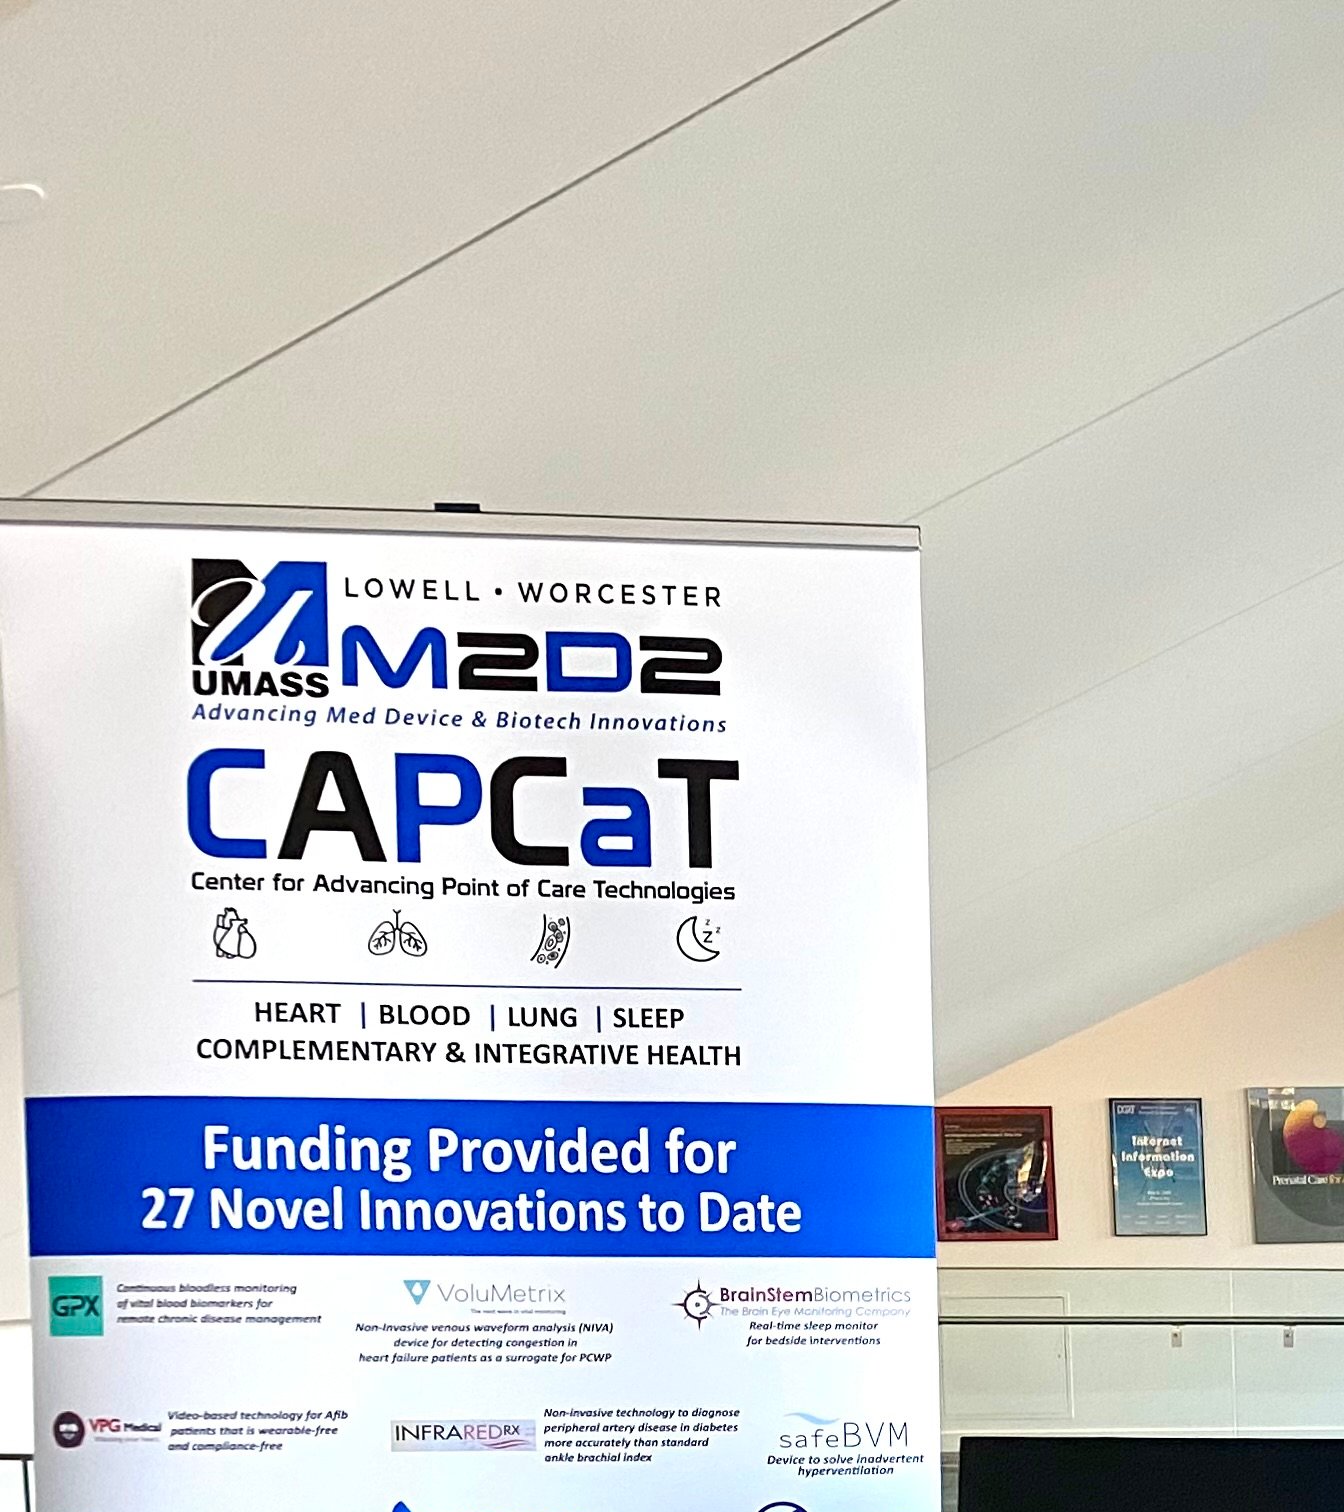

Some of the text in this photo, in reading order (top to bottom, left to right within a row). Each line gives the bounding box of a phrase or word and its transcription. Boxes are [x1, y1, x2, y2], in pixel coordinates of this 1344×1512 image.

[345, 577, 720, 607] LOWELL WORCESTER
[342, 624, 722, 696] M2D2
[192, 670, 329, 698] UMASS
[192, 703, 726, 733] Advancing Med Device & Biotech Innovations
[187, 748, 740, 868] CAPCaT
[191, 871, 735, 904] Center for Advancing Point of Care Technologies
[255, 1002, 684, 1028] HEART BLOOD LUNG SLEEP
[196, 1038, 740, 1066] COMPLEMENTARY & INTEGRATIVE HEALTH
[204, 1124, 736, 1183] Funding Provided for
[1131, 1135, 1183, 1146] Internet
[1121, 1151, 1195, 1162] Information
[1144, 1167, 1174, 1179] Expo
[142, 1186, 801, 1233] 27 Novel Innovations to Date
[51, 1295, 99, 1316] GPX
[437, 1283, 565, 1302] VoluMetrix
[720, 1286, 910, 1302] BrainStemBiometrics
[749, 1320, 878, 1331] Real-time sleep monitor
[745, 1335, 880, 1347] for bedside interventions
[779, 1421, 907, 1448] safeBVM
